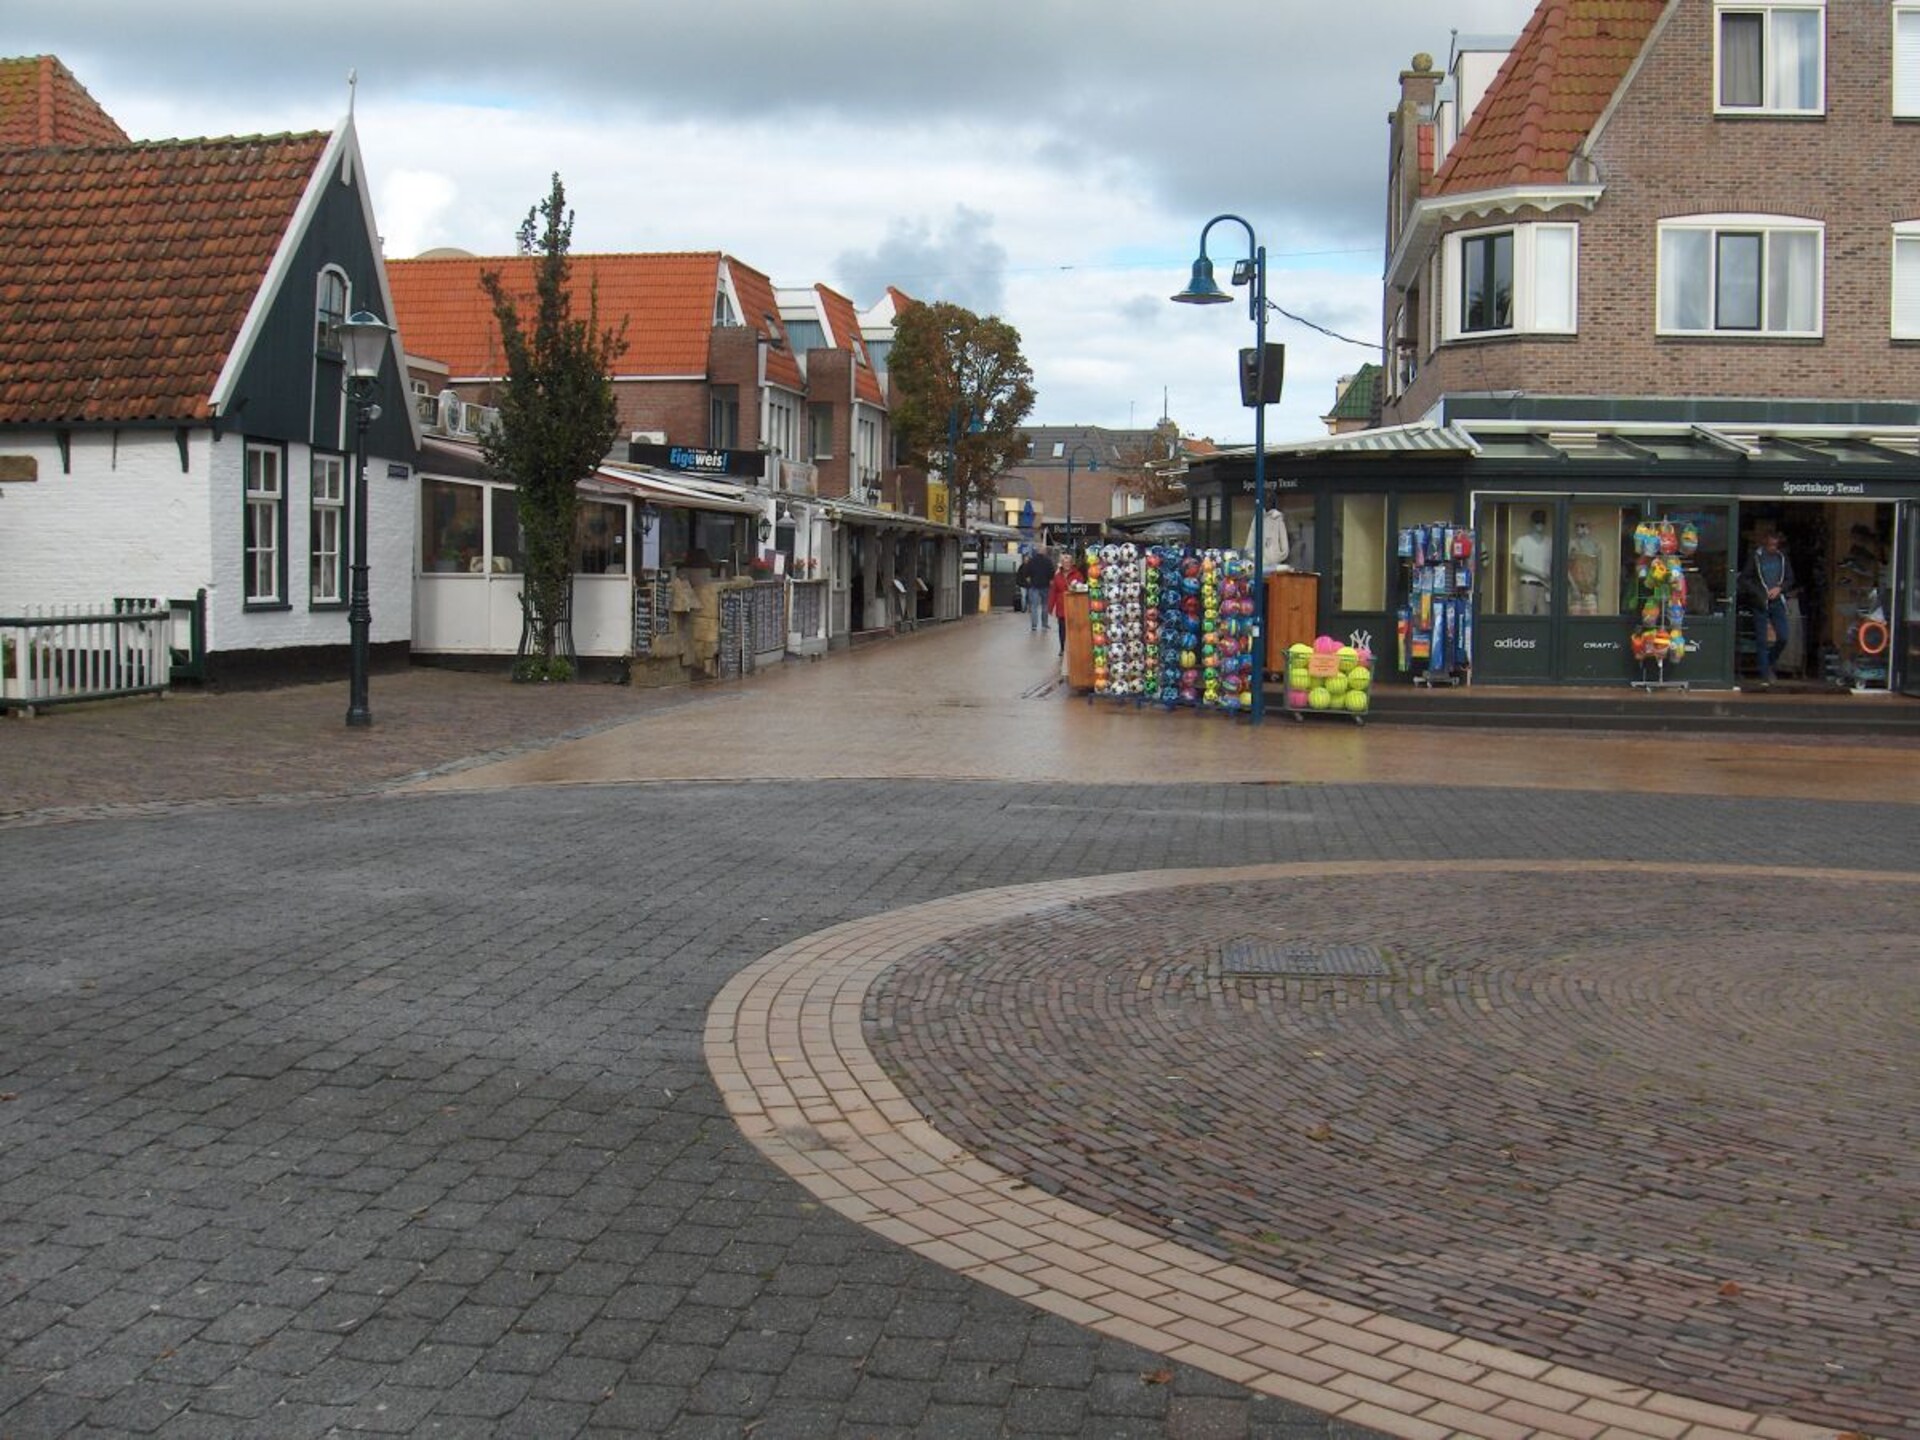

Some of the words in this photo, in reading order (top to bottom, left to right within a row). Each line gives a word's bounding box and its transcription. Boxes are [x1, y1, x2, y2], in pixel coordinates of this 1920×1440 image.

[1783, 481, 1834, 495] Sportshop
[1836, 482, 1864, 493] Texel
[1493, 638, 1537, 649] adidas
[1583, 641, 1612, 649] CRAFT
